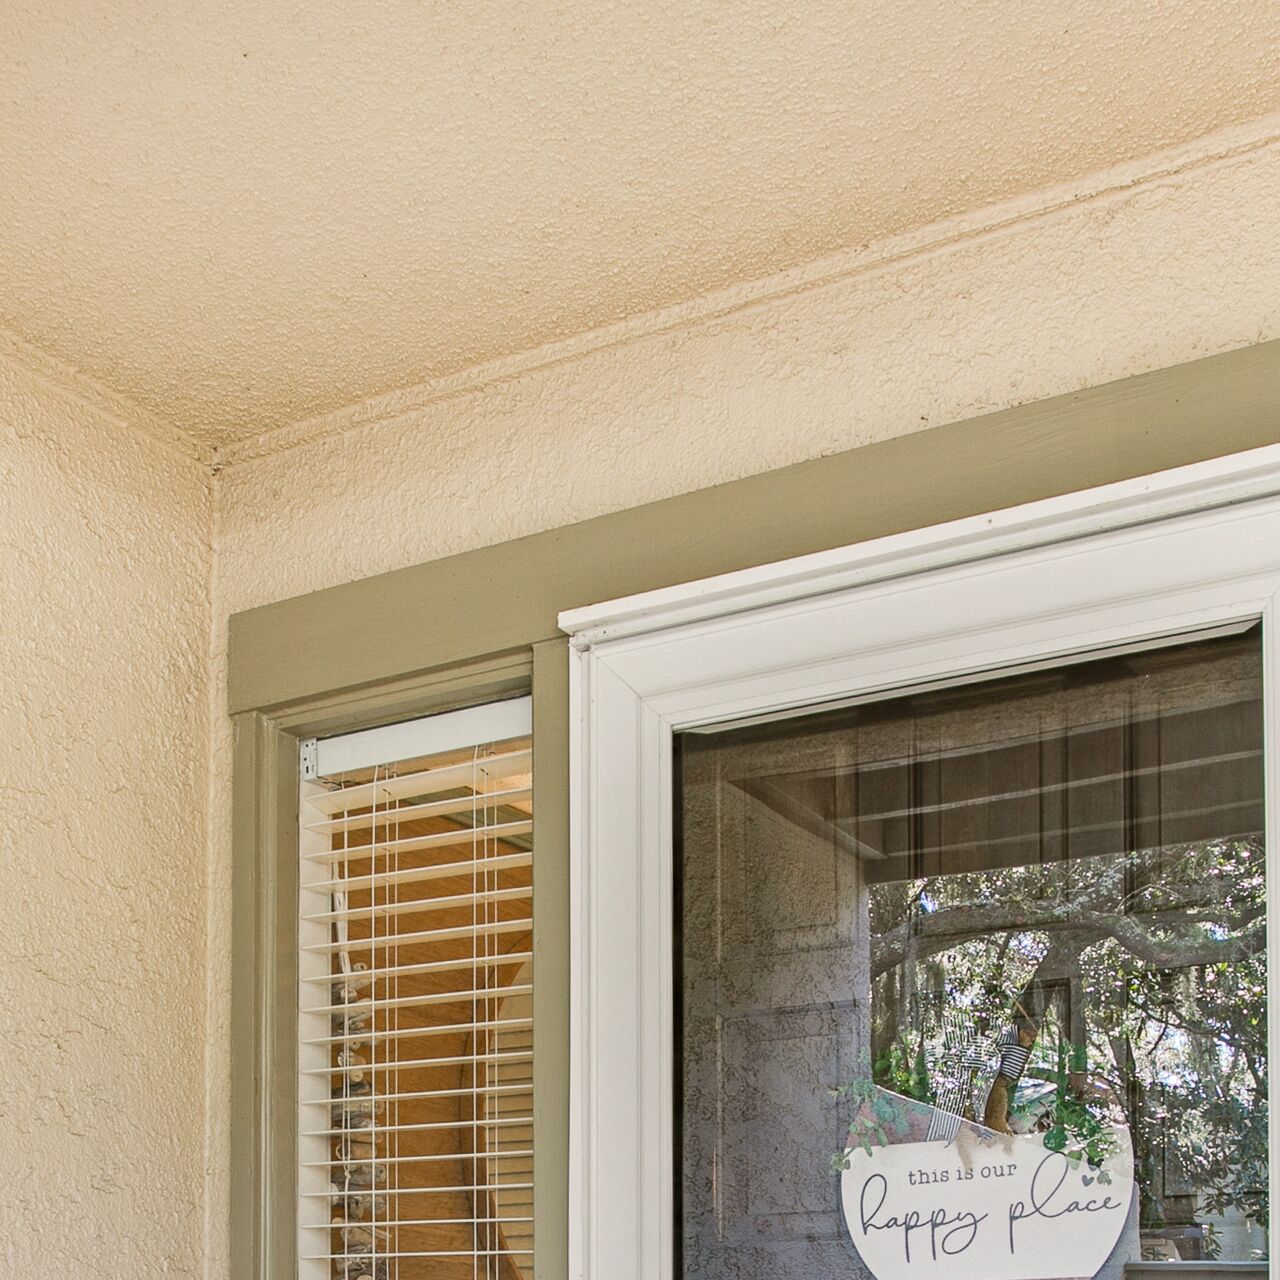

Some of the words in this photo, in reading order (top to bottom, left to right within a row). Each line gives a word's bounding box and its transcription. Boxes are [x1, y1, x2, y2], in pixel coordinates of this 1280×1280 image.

[860, 1173, 988, 1263] happy
[1009, 1151, 1122, 1255] place
[908, 1169, 950, 1186] this
[956, 1167, 974, 1181] is
[981, 1162, 1018, 1180] our
